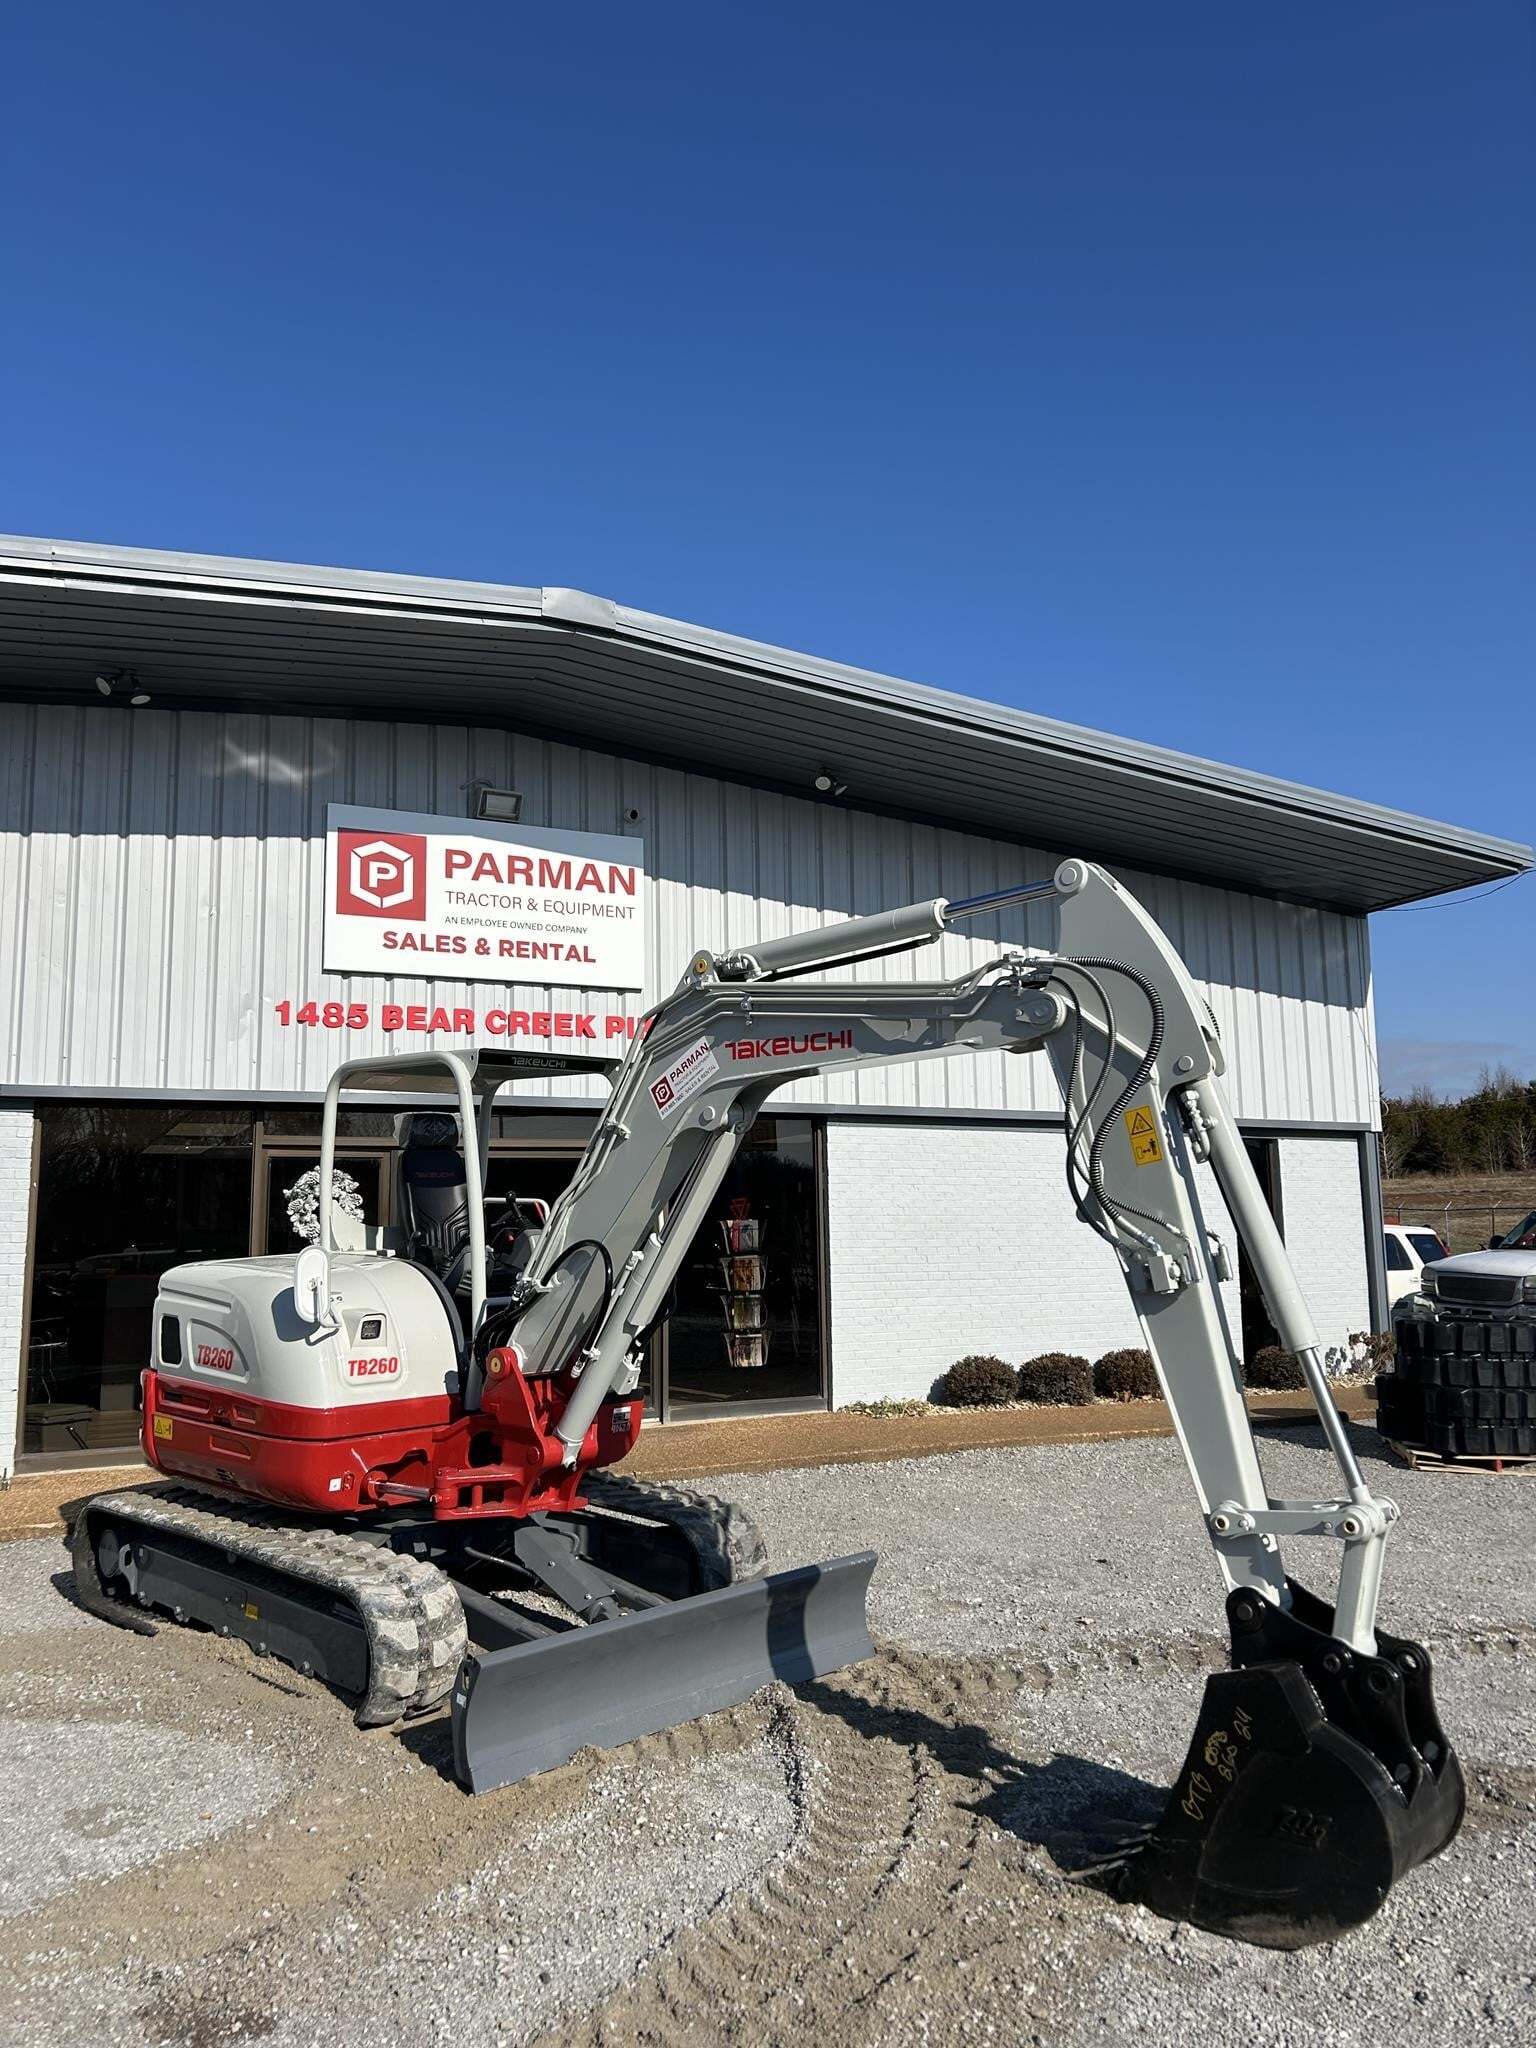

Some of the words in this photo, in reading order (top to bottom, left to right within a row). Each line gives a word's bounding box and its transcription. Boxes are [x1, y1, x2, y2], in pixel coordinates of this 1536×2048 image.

[368, 861, 399, 888] P
[445, 848, 635, 896] PARMAN
[444, 890, 522, 910] TRACTOR
[526, 898, 538, 911] &
[543, 899, 635, 920] EQUIPMENT
[444, 916, 458, 925] AN
[460, 917, 508, 929] EMPLOYEE
[509, 921, 543, 932] OWNED
[545, 923, 588, 935] COMPANY
[382, 931, 467, 954] SALES
[474, 938, 491, 956] &
[499, 939, 596, 964] RENTAL
[275, 1000, 369, 1030] 1485
[382, 1005, 475, 1035] BEAR
[485, 1009, 596, 1039] CREEK
[669, 1041, 708, 1082] PARMAN
[197, 1344, 234, 1371] TB260
[348, 1356, 398, 1377] TB260
